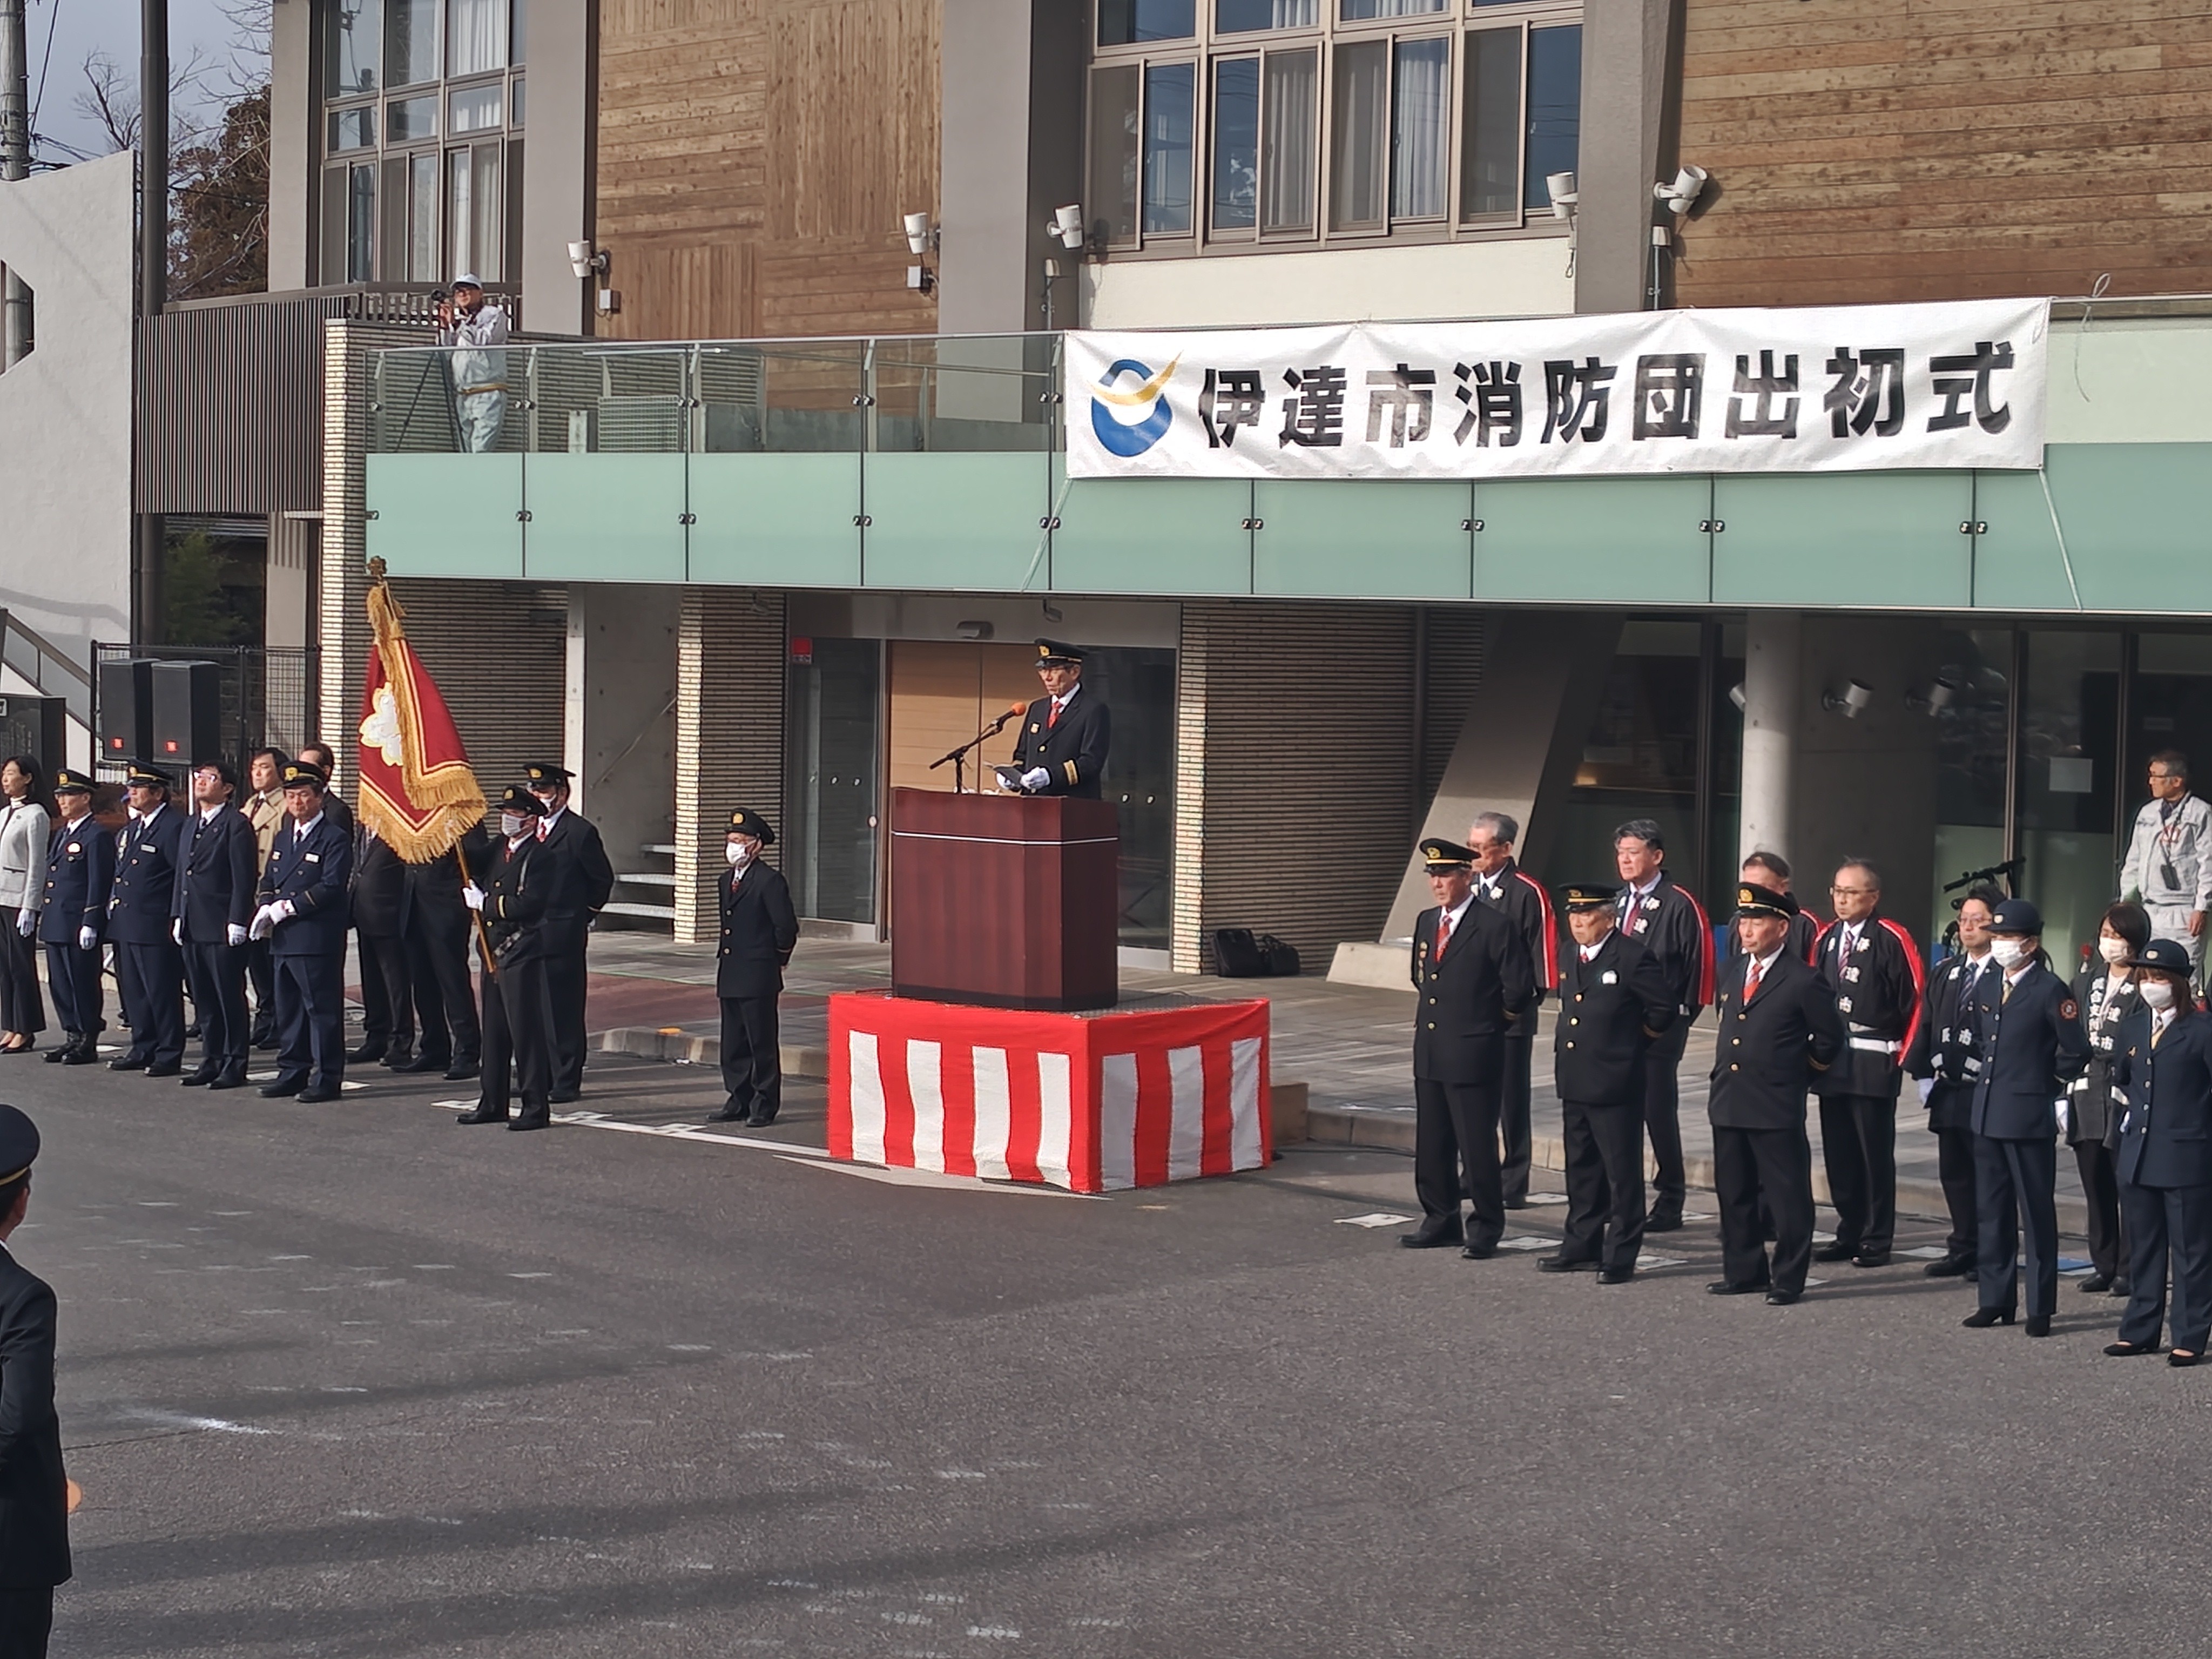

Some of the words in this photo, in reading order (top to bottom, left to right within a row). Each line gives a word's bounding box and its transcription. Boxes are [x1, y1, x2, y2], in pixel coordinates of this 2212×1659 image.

[1198, 341, 2014, 448] 伊達市消防団出初式
